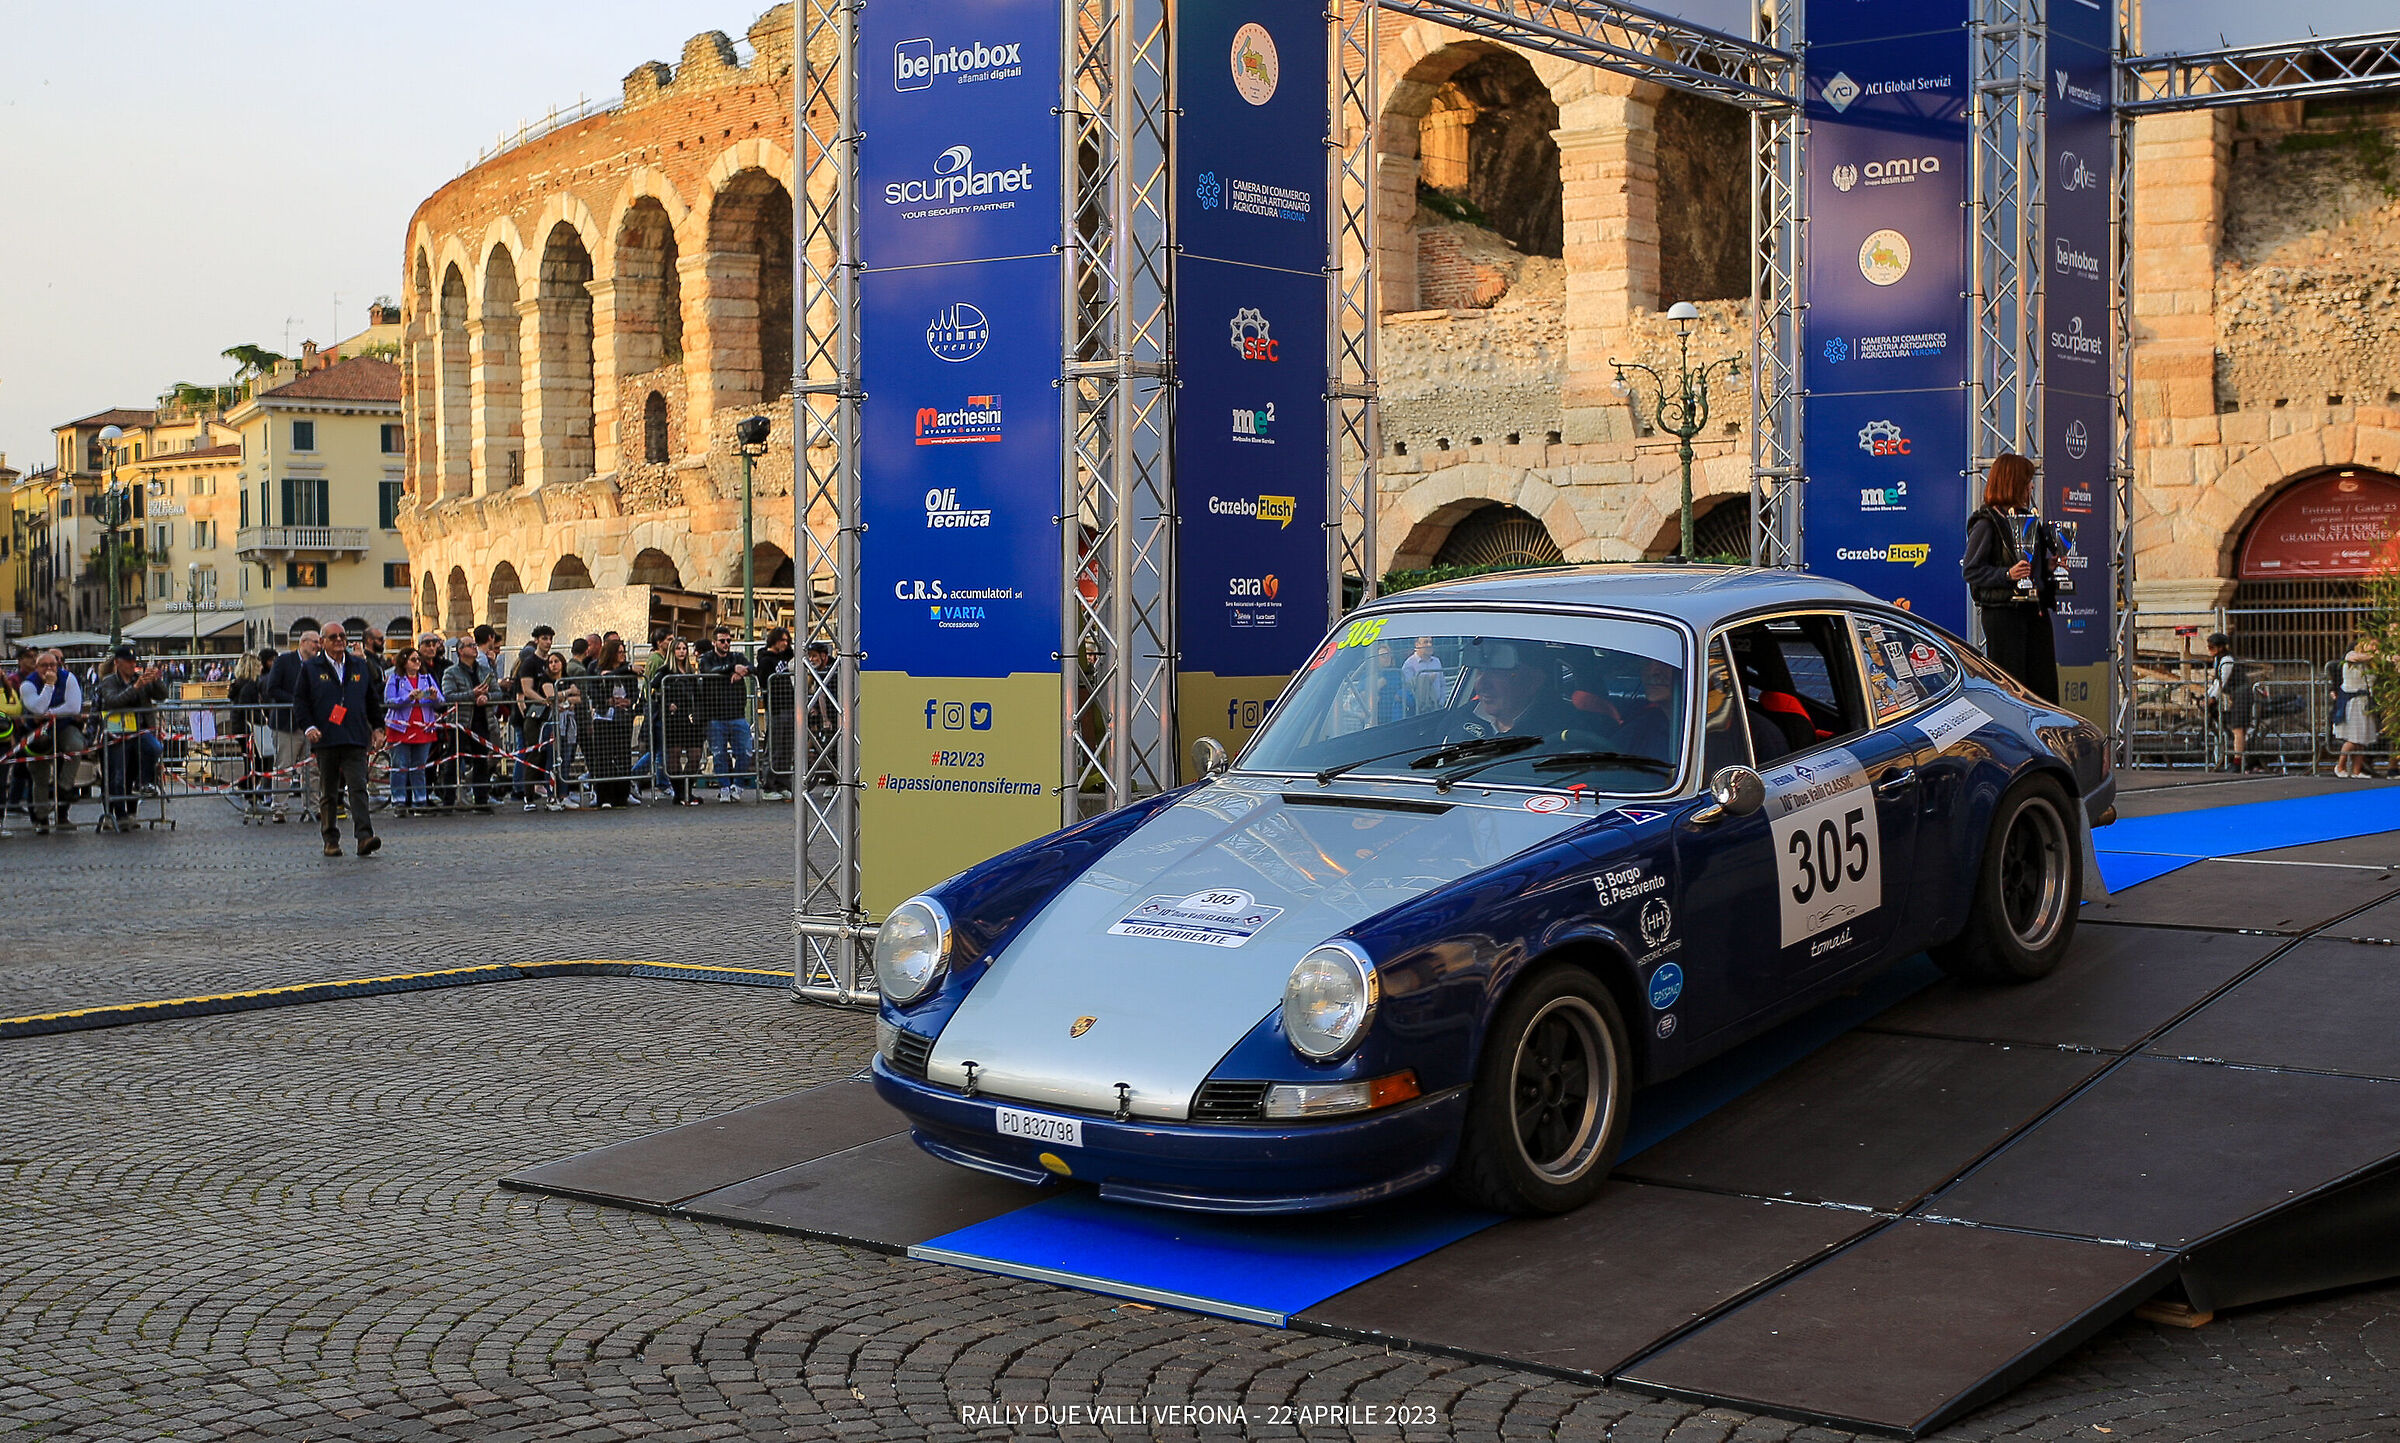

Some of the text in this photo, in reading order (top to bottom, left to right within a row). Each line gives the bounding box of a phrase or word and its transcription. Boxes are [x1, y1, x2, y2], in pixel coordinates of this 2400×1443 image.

[898, 41, 1021, 80] bentobox
[990, 66, 1022, 80] digitali
[1865, 74, 1952, 96] ACI Global Servizi
[1864, 156, 1940, 178] amia
[884, 161, 1033, 204] sicurplanet
[1232, 179, 1311, 202] CAMERA DI COMMERCIO
[901, 201, 1015, 220] YOUR SECURITY PARTNER
[1232, 190, 1311, 213] INDUSTRIA ARTIGIANATO
[1232, 200, 1306, 222] AGRICOLTURA VERONA
[2057, 244, 2099, 272] bentobox
[1861, 332, 1947, 345] CAMERA DI COMMERCIO
[1861, 340, 1947, 352] INDUSTRIA ARTIGIANATO
[2051, 329, 2102, 355] sicurplanet
[1243, 336, 1280, 363] SEC
[1861, 349, 1911, 360] AGRICOLTURA
[915, 407, 1002, 437] Marchesini
[924, 428, 957, 436] STAMPA
[965, 426, 1001, 434] GRAFICA
[1873, 438, 1911, 456] SEC
[926, 510, 991, 528] Tecnica
[2301, 505, 2341, 516] Entrata
[2354, 503, 2381, 513] Gate
[2329, 521, 2379, 533] SETTORE
[2280, 531, 2350, 543] GRADINATA
[894, 580, 1023, 600] C.R.S. accumulatori srl
[1229, 578, 1261, 596] sara
[944, 606, 985, 620] VARTA
[938, 621, 979, 629] Concessionario
[1337, 618, 1389, 650] 305
[1927, 722, 1953, 739] Banca
[931, 750, 985, 768] #R2V23
[877, 773, 1041, 796] #lapassionenonsiferma
[1793, 791, 1811, 808] Due
[1806, 783, 1826, 801] Valli
[1824, 774, 1854, 796] CLASSIC
[1538, 799, 1556, 808] E
[1788, 807, 1869, 905] 305
[1201, 892, 1241, 906] 305
[1173, 909, 1188, 918] Due
[1187, 911, 1207, 920] Valli
[1205, 913, 1240, 924] CLASSIC
[1646, 910, 1665, 931] HH
[1123, 925, 1229, 945] CONCORRENTE
[1002, 1112, 1074, 1142] PD 832798
